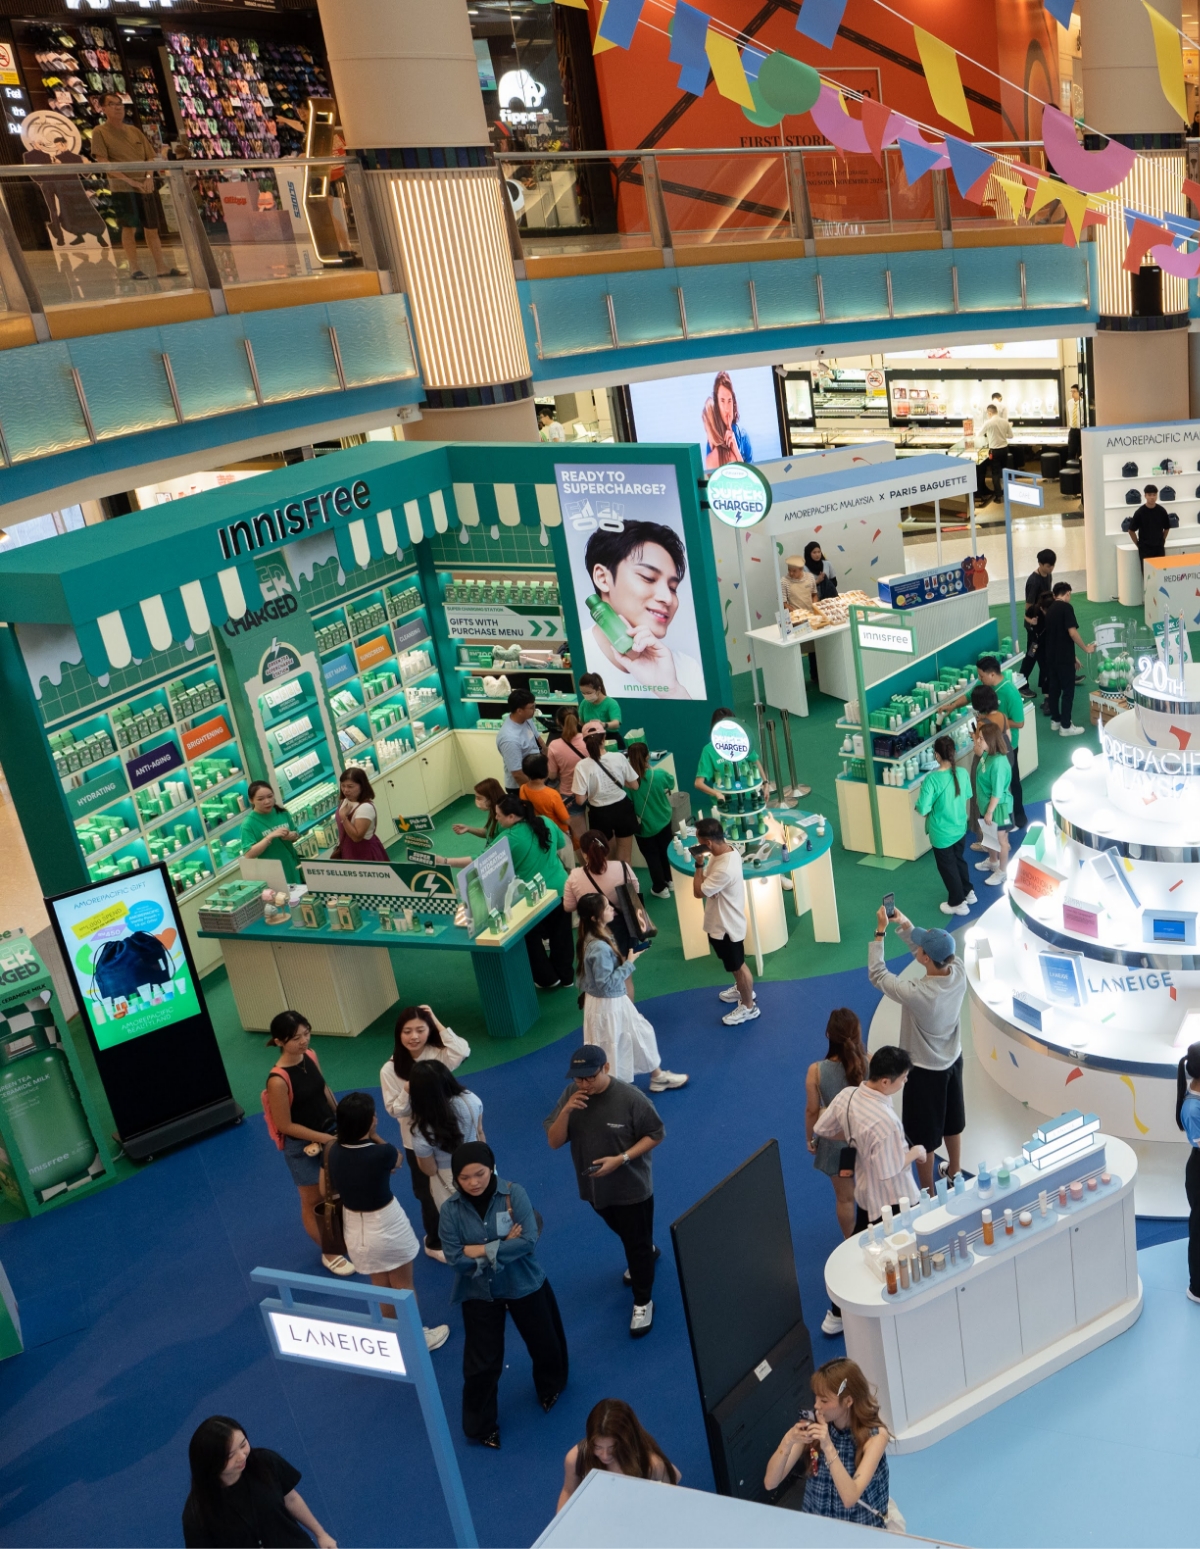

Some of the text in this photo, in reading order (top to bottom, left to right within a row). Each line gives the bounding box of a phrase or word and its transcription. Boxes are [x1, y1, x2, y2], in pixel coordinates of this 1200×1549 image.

[5, 88, 22, 99] Feel
[11, 107, 26, 117] the
[740, 136, 780, 147] FIRST
[1106, 432, 1181, 447] AMOREPACIFIC
[561, 471, 625, 482] READY TO
[563, 483, 667, 495] SUPERCHARGE?
[784, 502, 839, 522] AMOREPACIFIC
[839, 495, 875, 509] MALAYSIA
[889, 486, 918, 499] PARIS
[920, 475, 968, 493] BAGUETTE
[712, 499, 764, 513] CHARGED
[450, 617, 499, 627] GIFTS WITH
[399, 627, 421, 643] CLEANSING
[452, 627, 524, 637] PURCHASE MENU
[360, 645, 385, 661] SUNSCREEN
[186, 726, 224, 750] BRIGHTENING
[715, 742, 748, 753] CHARGED
[135, 753, 172, 778] ANTI-AGING
[76, 782, 117, 807] HYDRATING
[307, 868, 391, 880] BEST SELLERS STATION
[73, 881, 146, 910] AMOREPACIFIC GIFT
[102, 908, 122, 920] SPEND
[30, 983, 47, 994] MILK
[1088, 971, 1174, 993] LANEIGE
[121, 1006, 174, 1031] AMOREPACIFIC
[18, 1075, 32, 1086] TEA
[33, 1073, 50, 1086] MILK
[289, 1324, 391, 1358] LANEIGE
